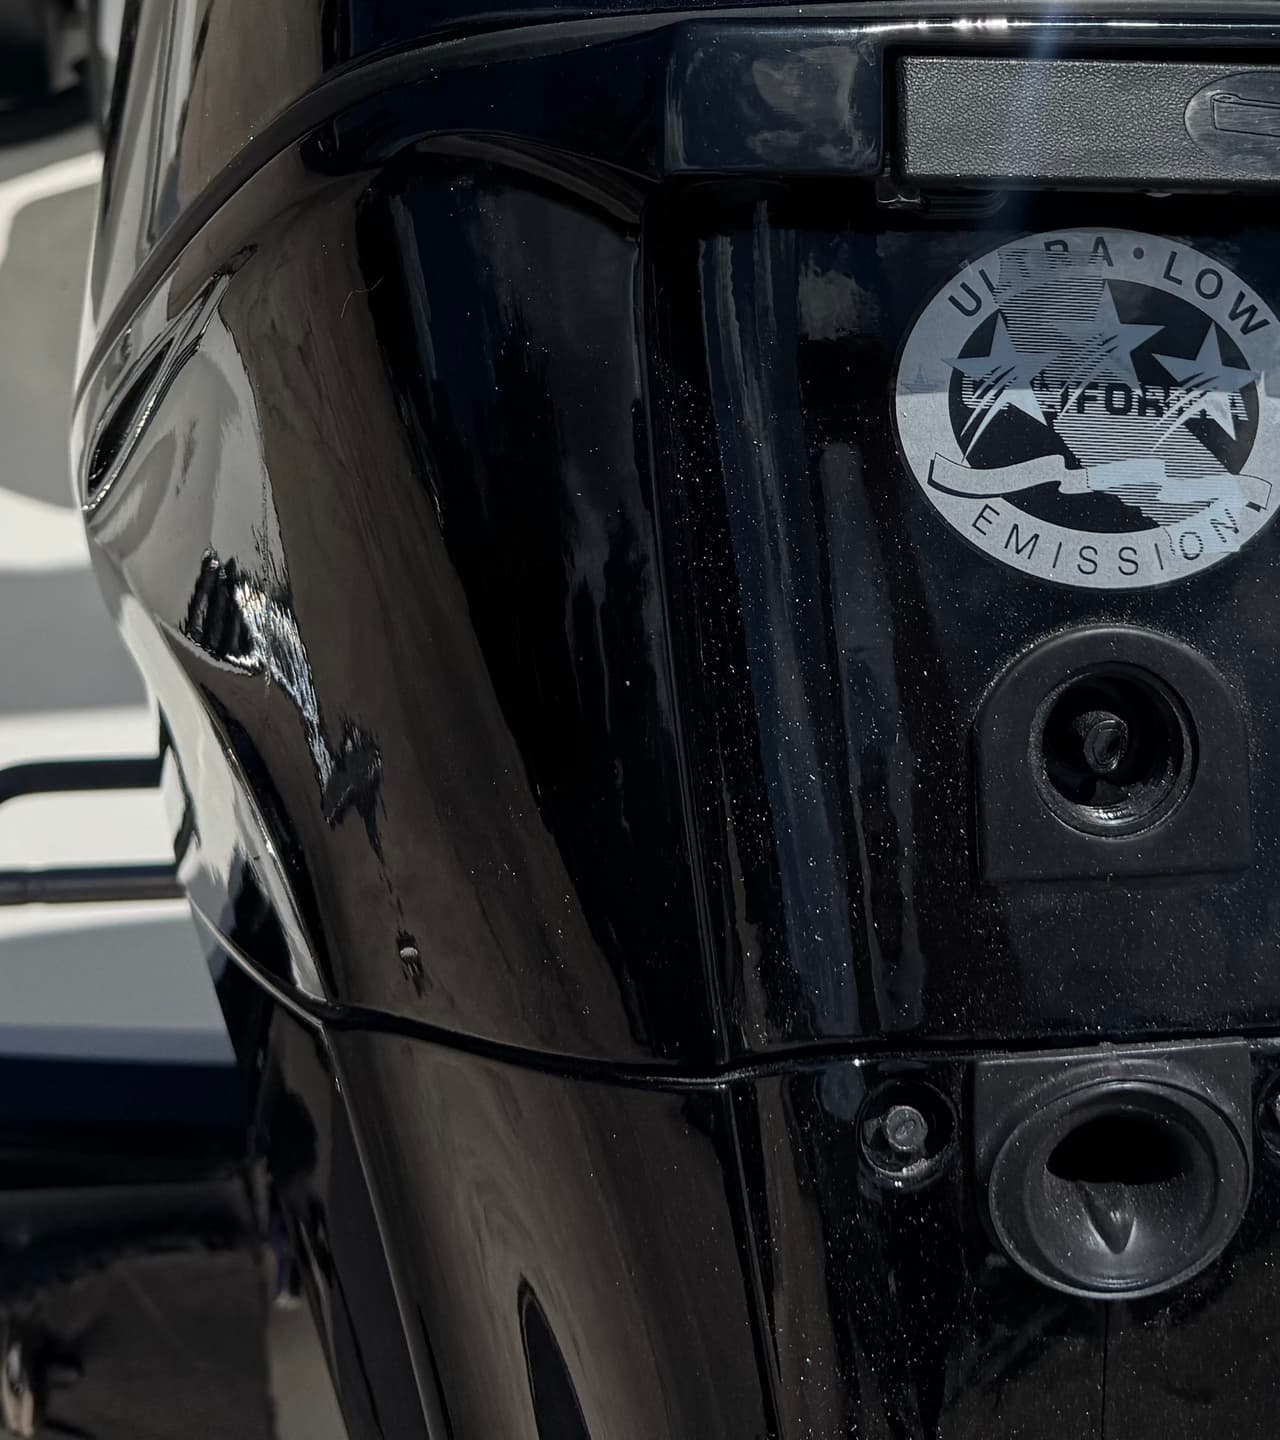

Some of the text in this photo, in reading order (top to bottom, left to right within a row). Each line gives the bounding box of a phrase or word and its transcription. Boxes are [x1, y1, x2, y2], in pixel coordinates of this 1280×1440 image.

[947, 235, 1271, 336] ULTRA LOW
[971, 503, 1240, 576] EMISSION
